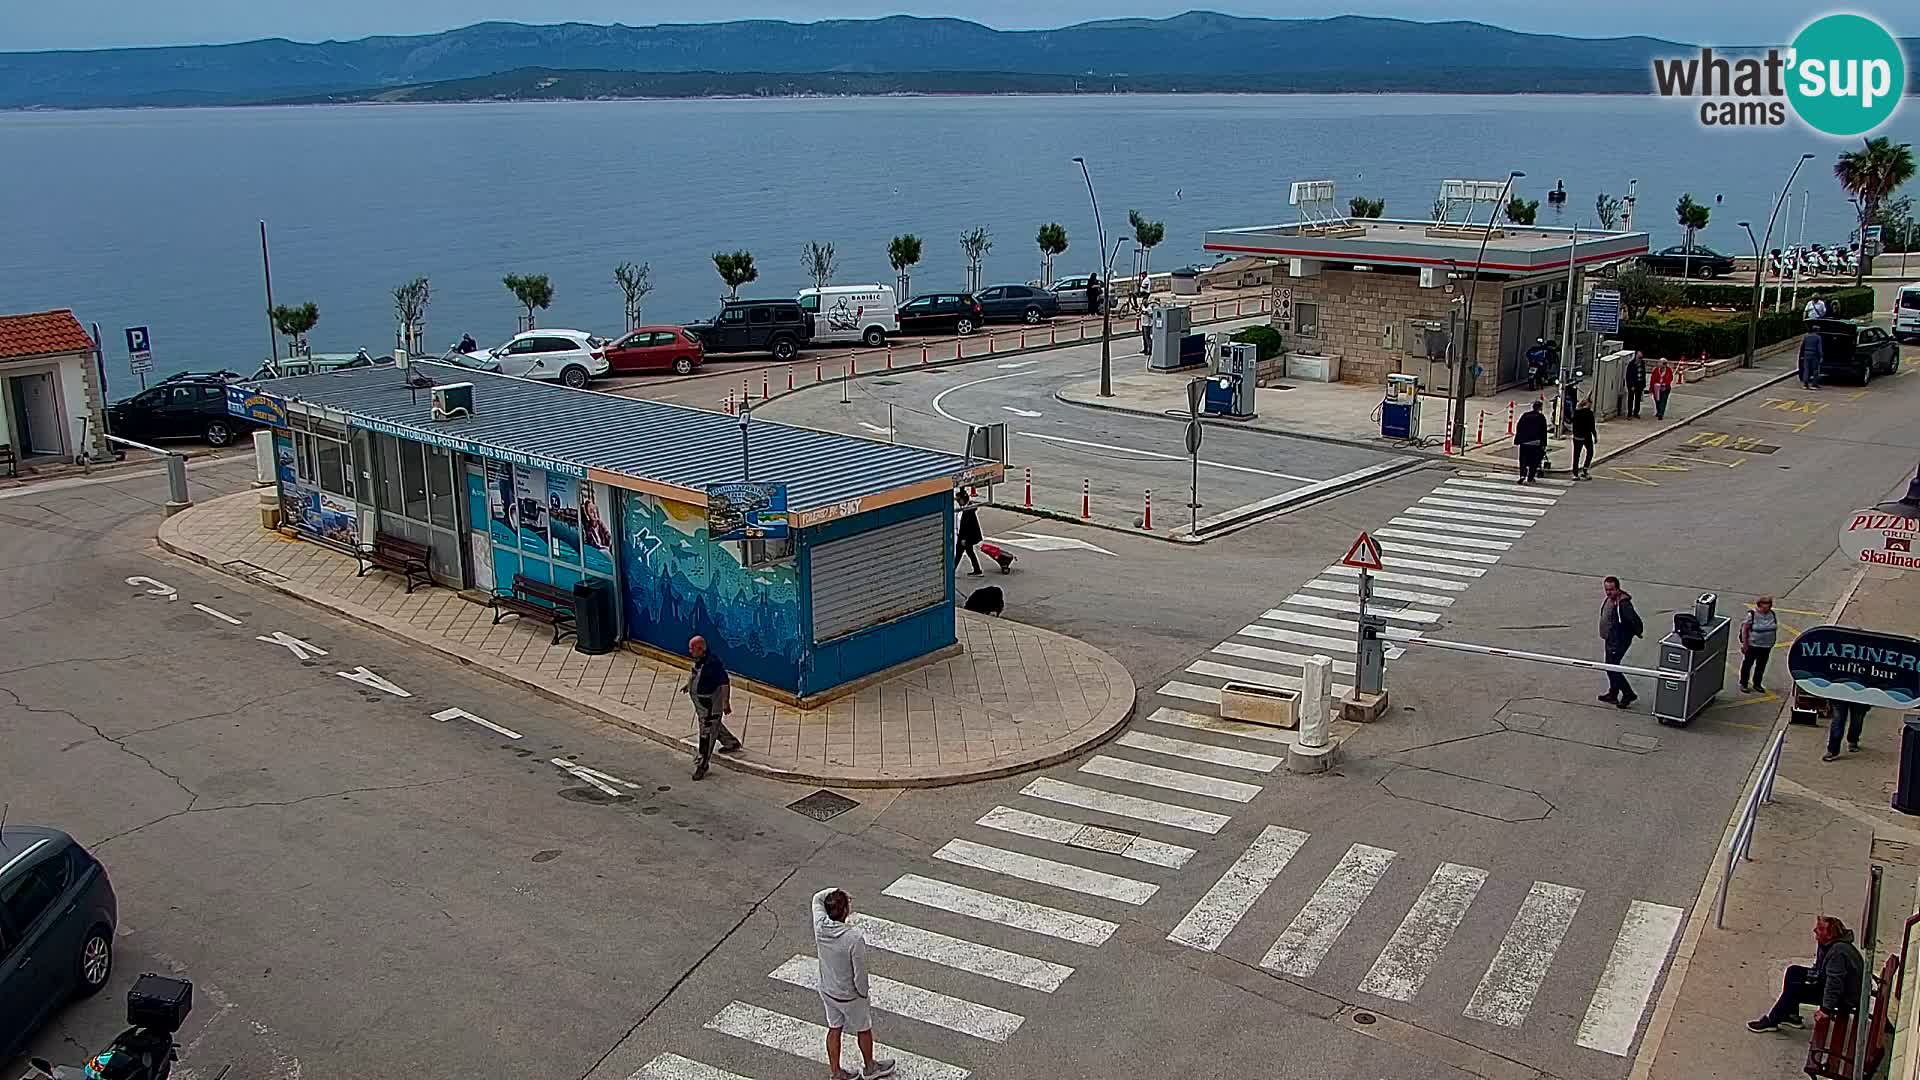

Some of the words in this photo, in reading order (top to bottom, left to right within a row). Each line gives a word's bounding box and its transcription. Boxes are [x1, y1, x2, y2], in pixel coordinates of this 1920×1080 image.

[131, 330, 143, 349] P
[1760, 398, 1830, 413] TAXI
[1687, 432, 1764, 450] TAXI
[397, 426, 437, 443] AUTOBUSNA
[437, 436, 469, 452] POSTAJA
[480, 446, 494, 457] BUS
[495, 450, 527, 465] STATION
[529, 456, 555, 470] TICKET
[556, 462, 583, 476] OFFICE
[1848, 515, 1920, 532] PIZZE
[1882, 530, 1917, 540] GRILL
[1829, 662, 1866, 675] caffe
[1871, 665, 1897, 679] bar
